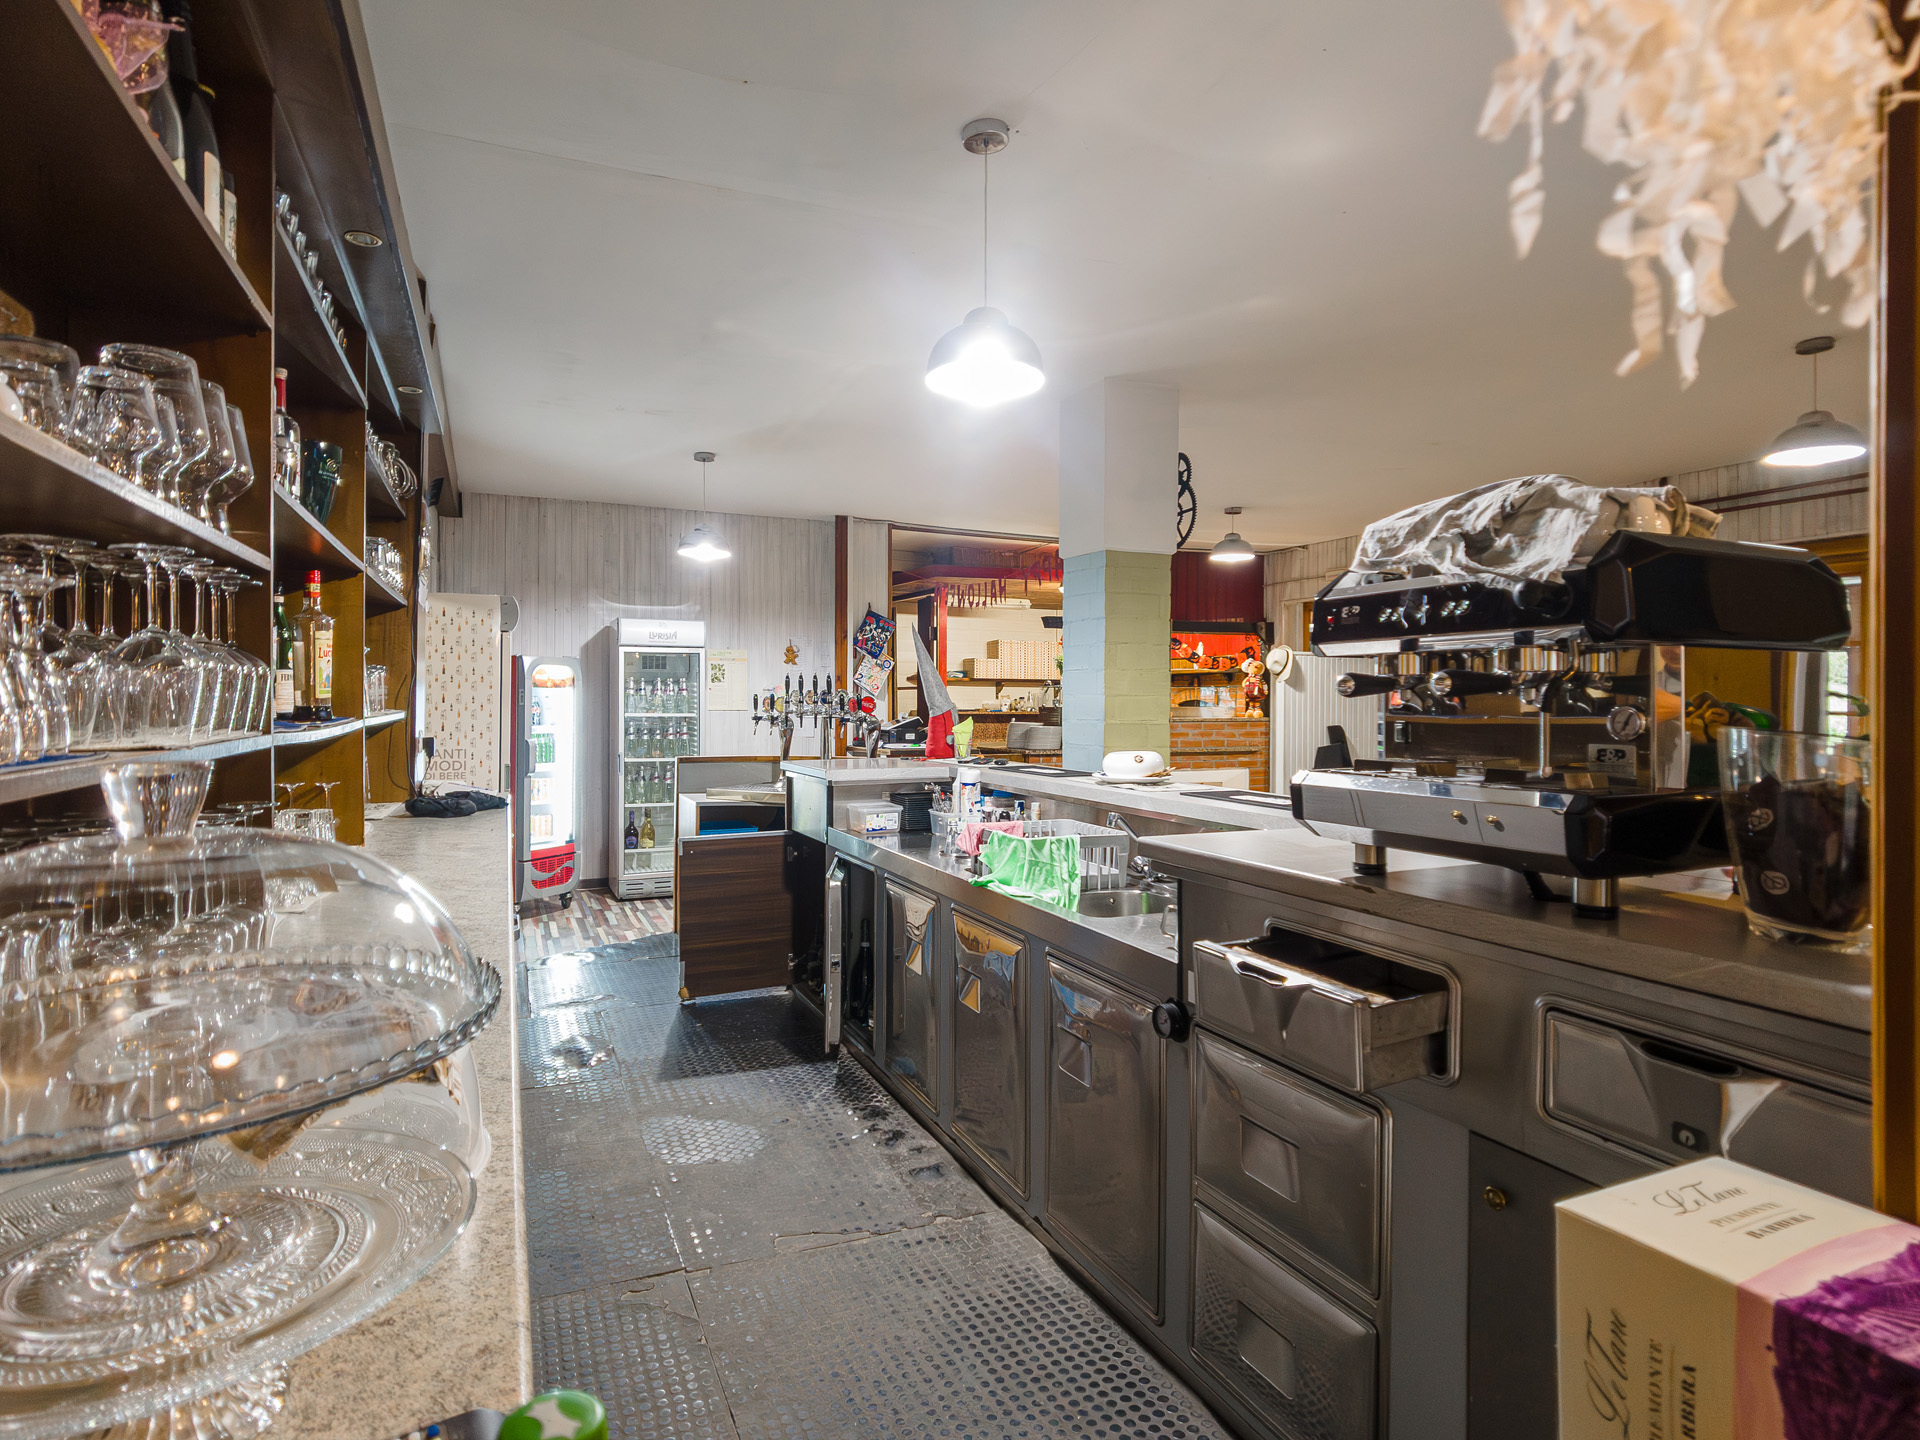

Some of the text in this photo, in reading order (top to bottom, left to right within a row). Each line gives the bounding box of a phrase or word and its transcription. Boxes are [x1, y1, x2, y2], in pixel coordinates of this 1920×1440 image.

[432, 748, 467, 760] ANTI
[439, 772, 467, 780] BERE
[1708, 1201, 1783, 1228] PIEMONTE
[1745, 1213, 1816, 1240] BARBERA
[1648, 1339, 1663, 1440] IEMONTE
[1680, 1365, 1696, 1440] RBERA
